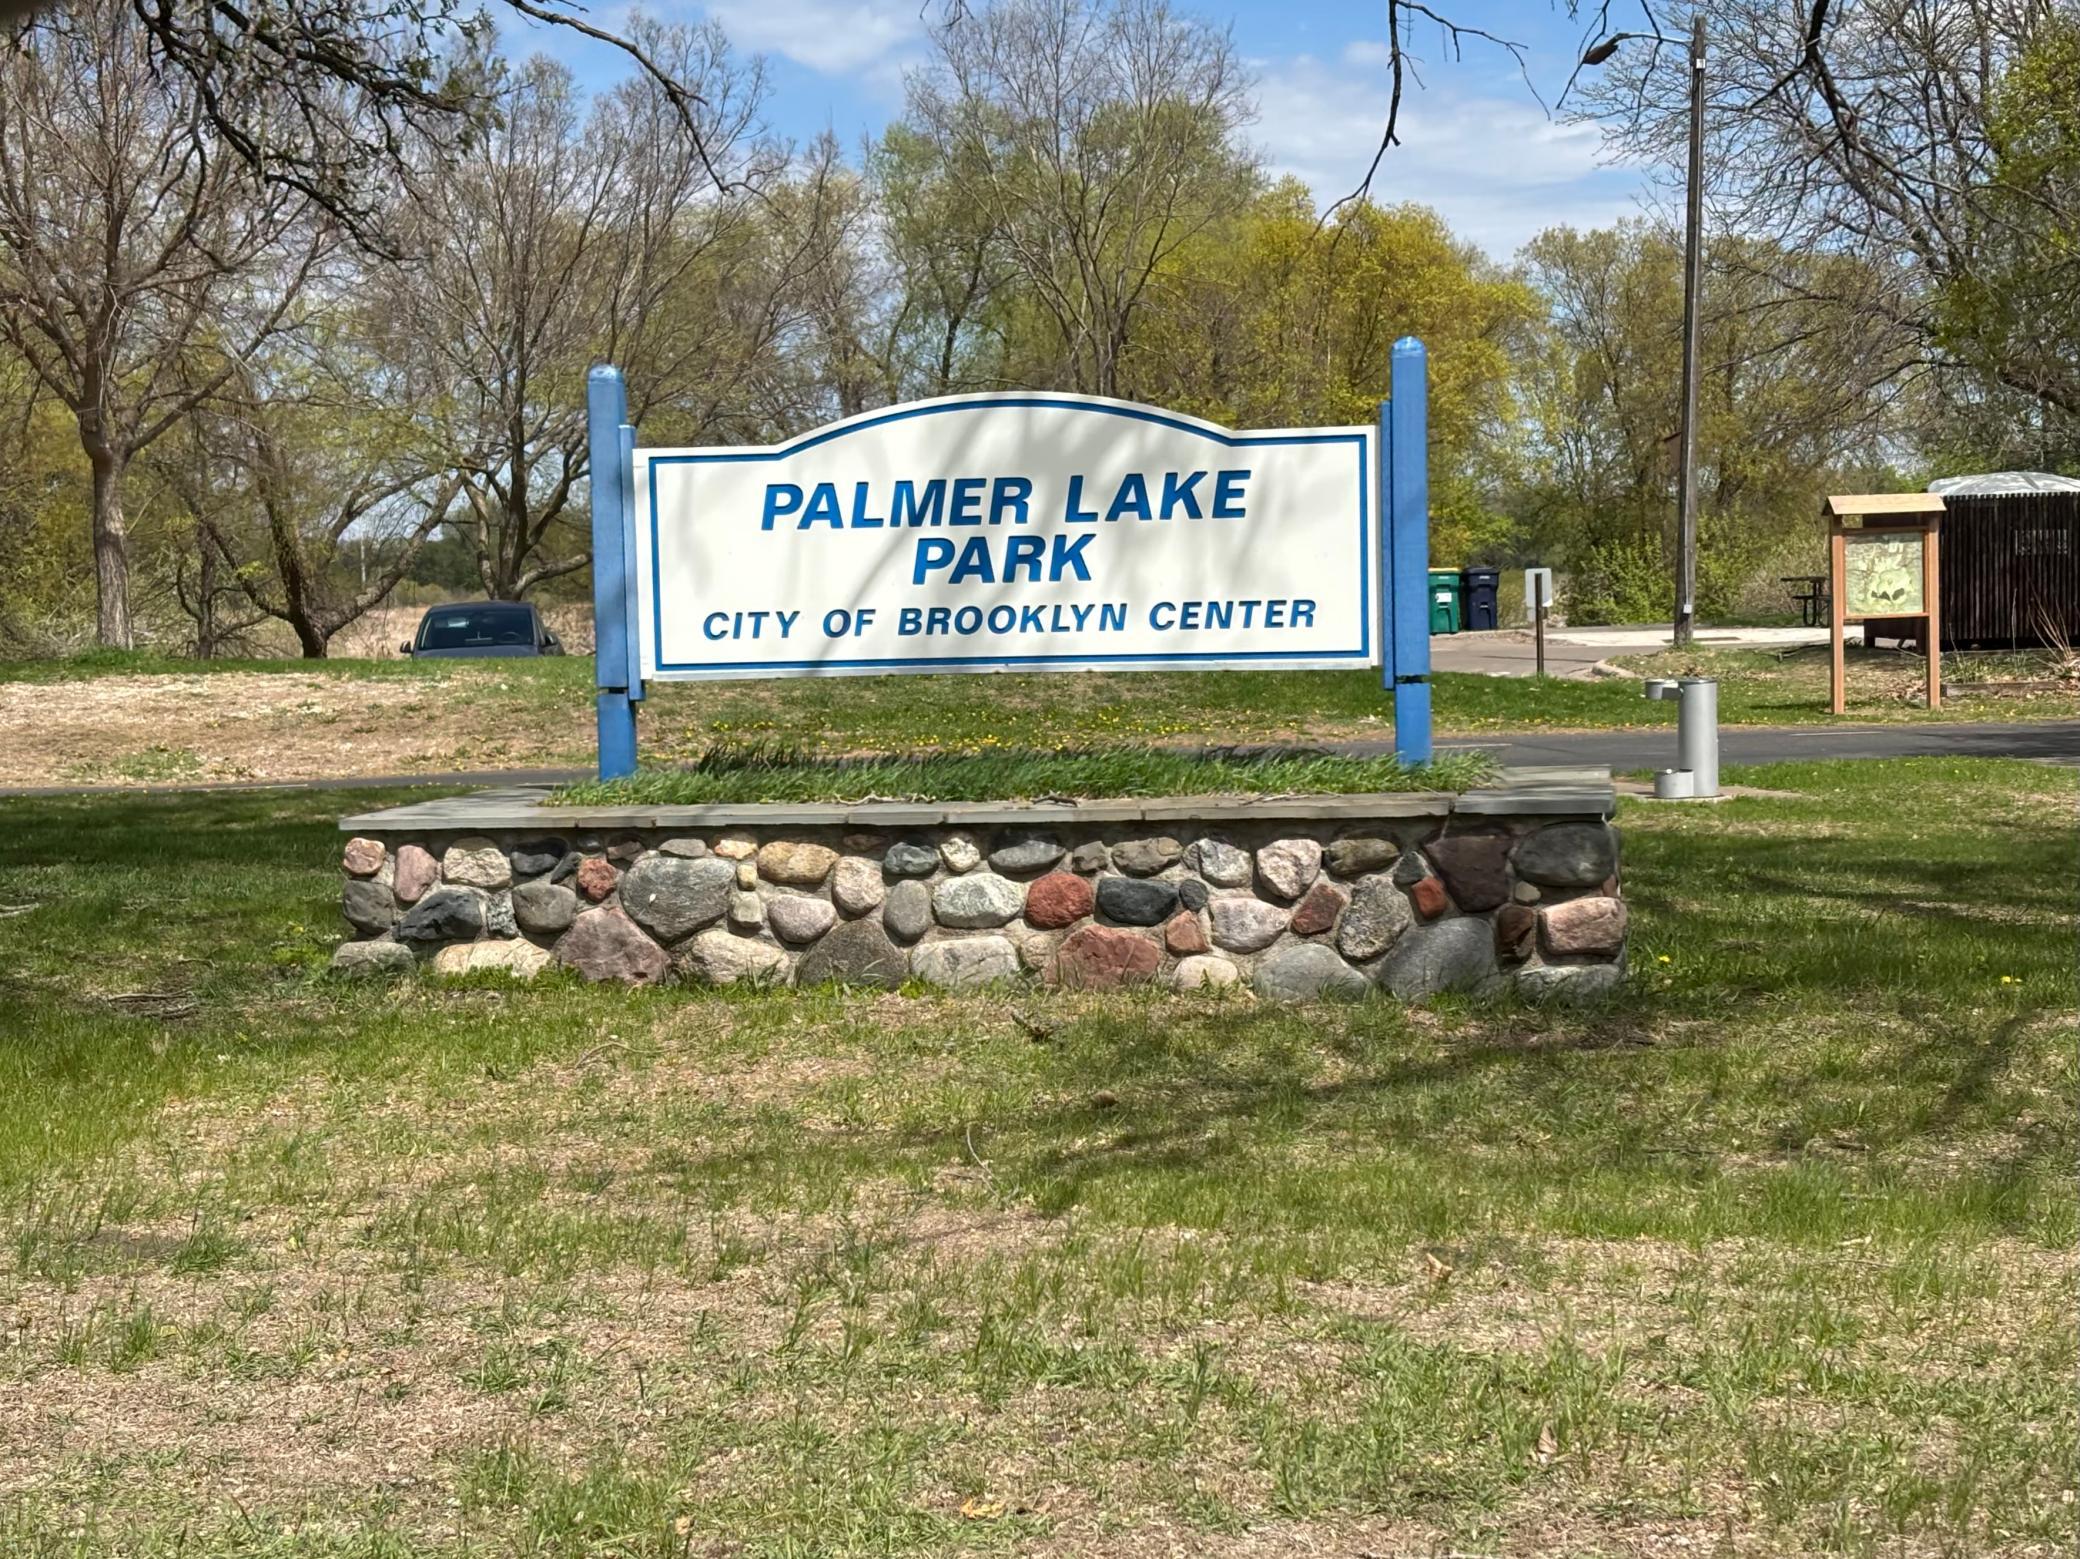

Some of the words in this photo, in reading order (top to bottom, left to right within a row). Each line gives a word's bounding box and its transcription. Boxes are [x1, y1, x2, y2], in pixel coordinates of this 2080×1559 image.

[761, 477, 1032, 531] PALMER
[1064, 470, 1251, 524] LAKE
[912, 533, 1096, 585] PARK
[703, 611, 799, 641] CITY
[822, 607, 873, 637] OF
[898, 603, 1127, 636] BROOKLYN
[1149, 599, 1317, 630] CENTER
